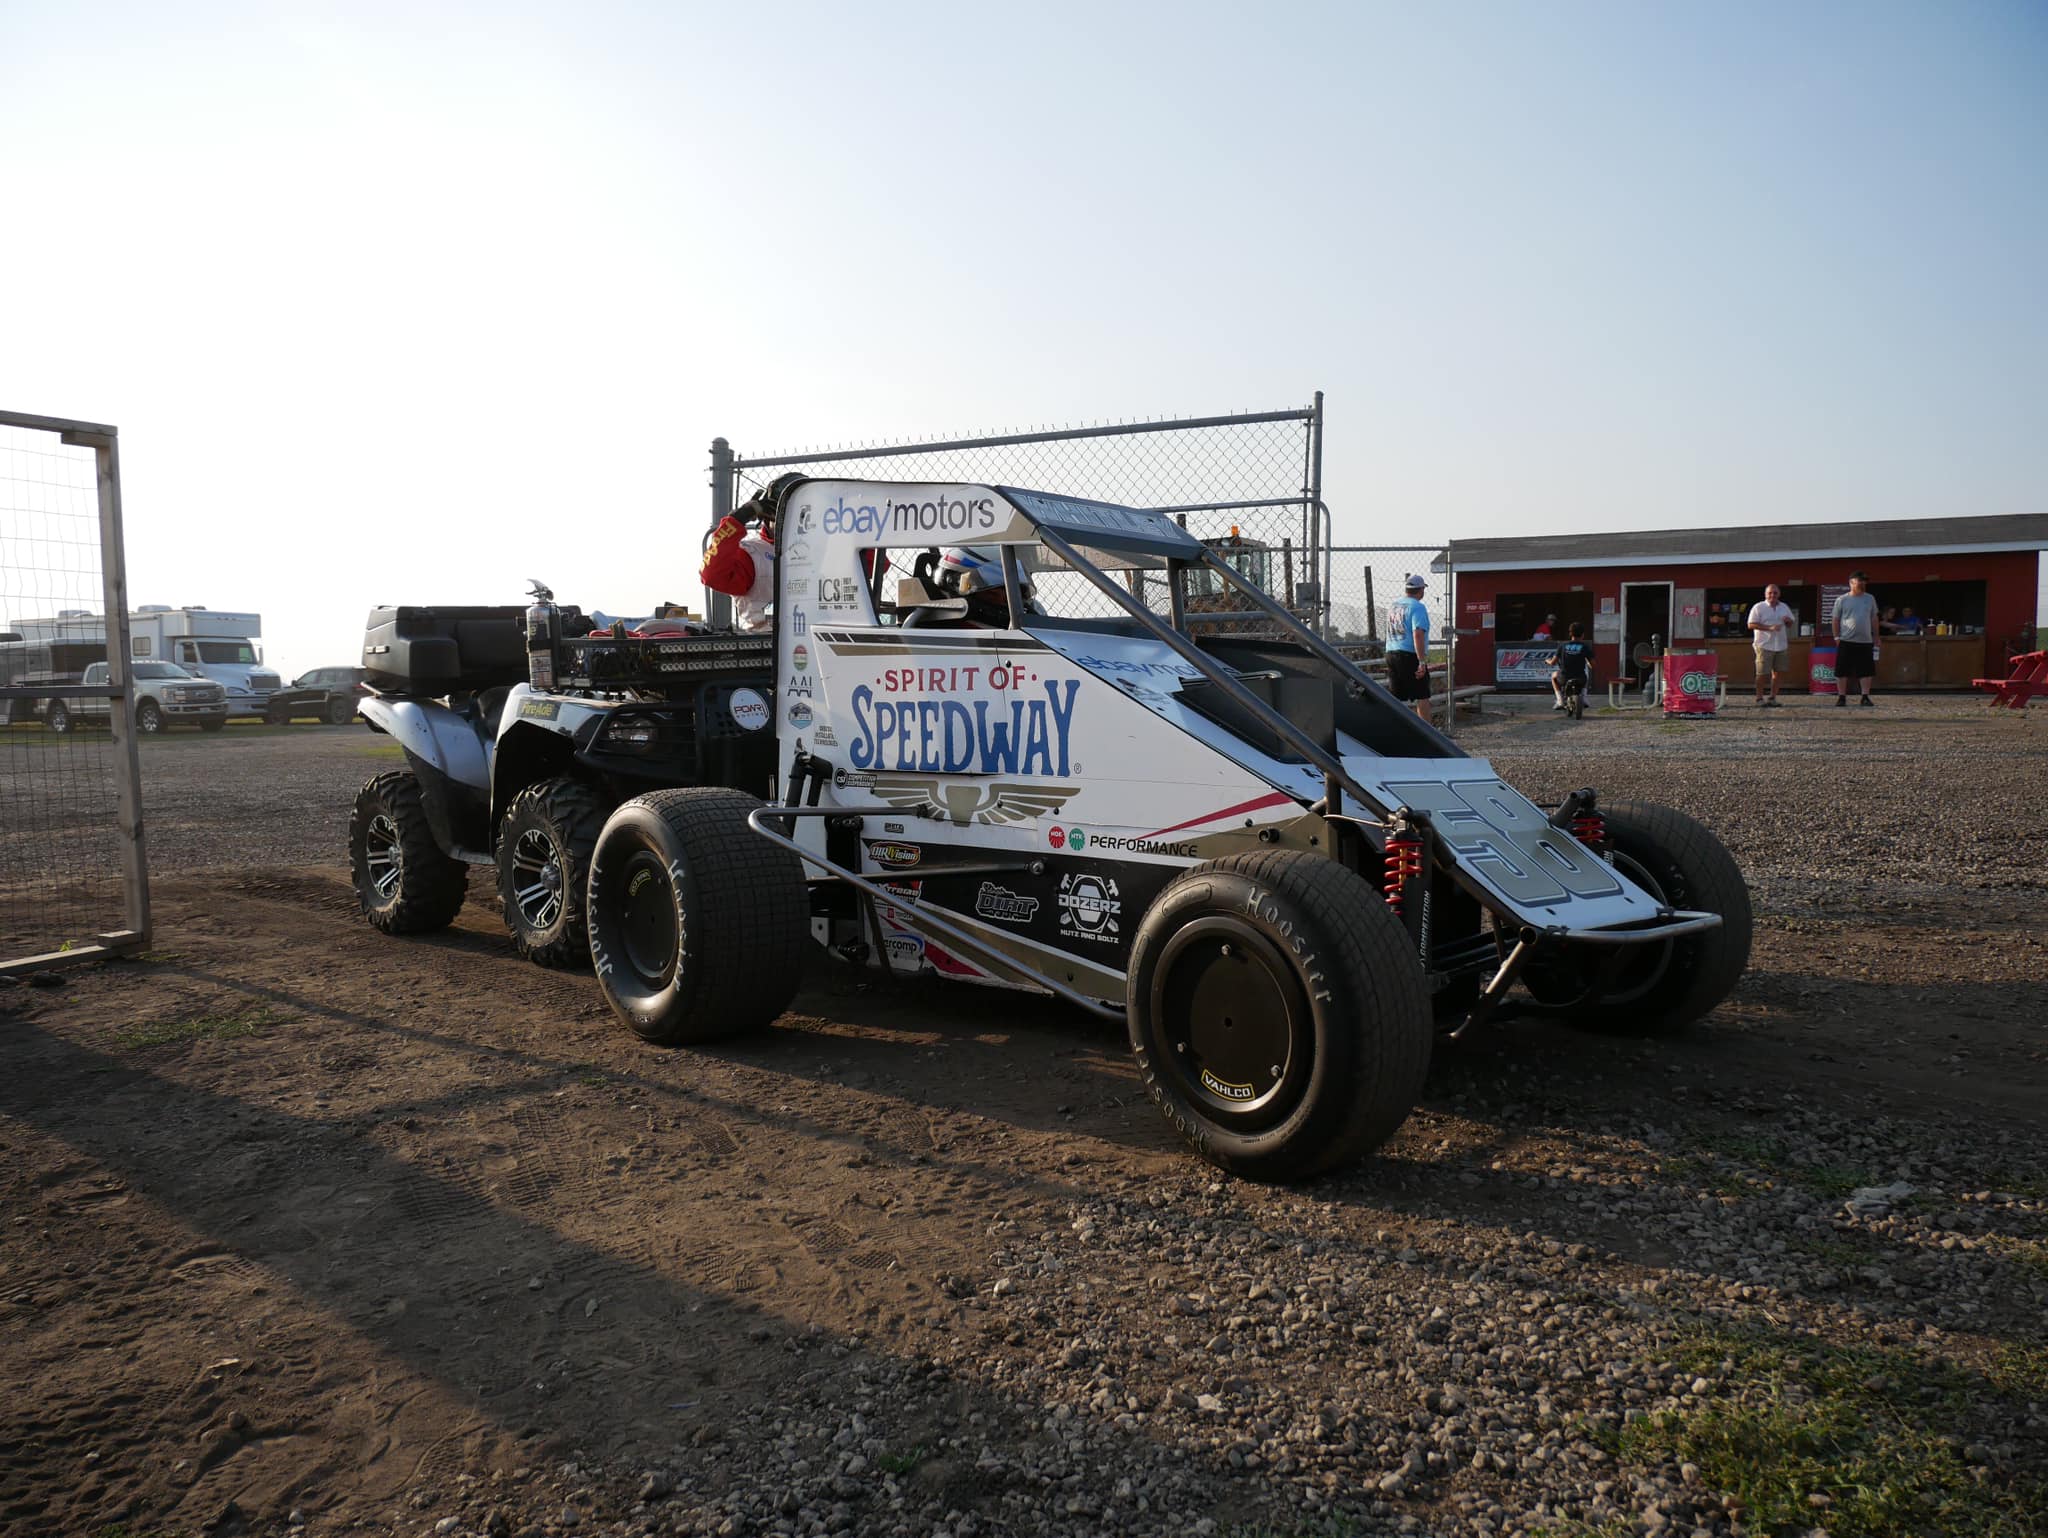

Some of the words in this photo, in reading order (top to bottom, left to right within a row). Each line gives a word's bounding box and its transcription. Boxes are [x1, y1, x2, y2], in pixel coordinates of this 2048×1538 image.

[823, 498, 891, 541] ebay
[894, 494, 994, 531] motors
[819, 579, 840, 602] ICS
[885, 668, 980, 693] SPIRIT
[989, 666, 1026, 690] OF
[850, 679, 1081, 778] SPEEDWAY
[1090, 836, 1198, 857] PERFORMANCE
[1381, 779, 1624, 907] 58
[978, 894, 1035, 914] DIRT
[1058, 894, 1121, 914] DOZERZ
[1081, 932, 1096, 940] AND
[1242, 887, 1332, 1002] Hoosier
[1205, 1075, 1251, 1098] VAHLCO
